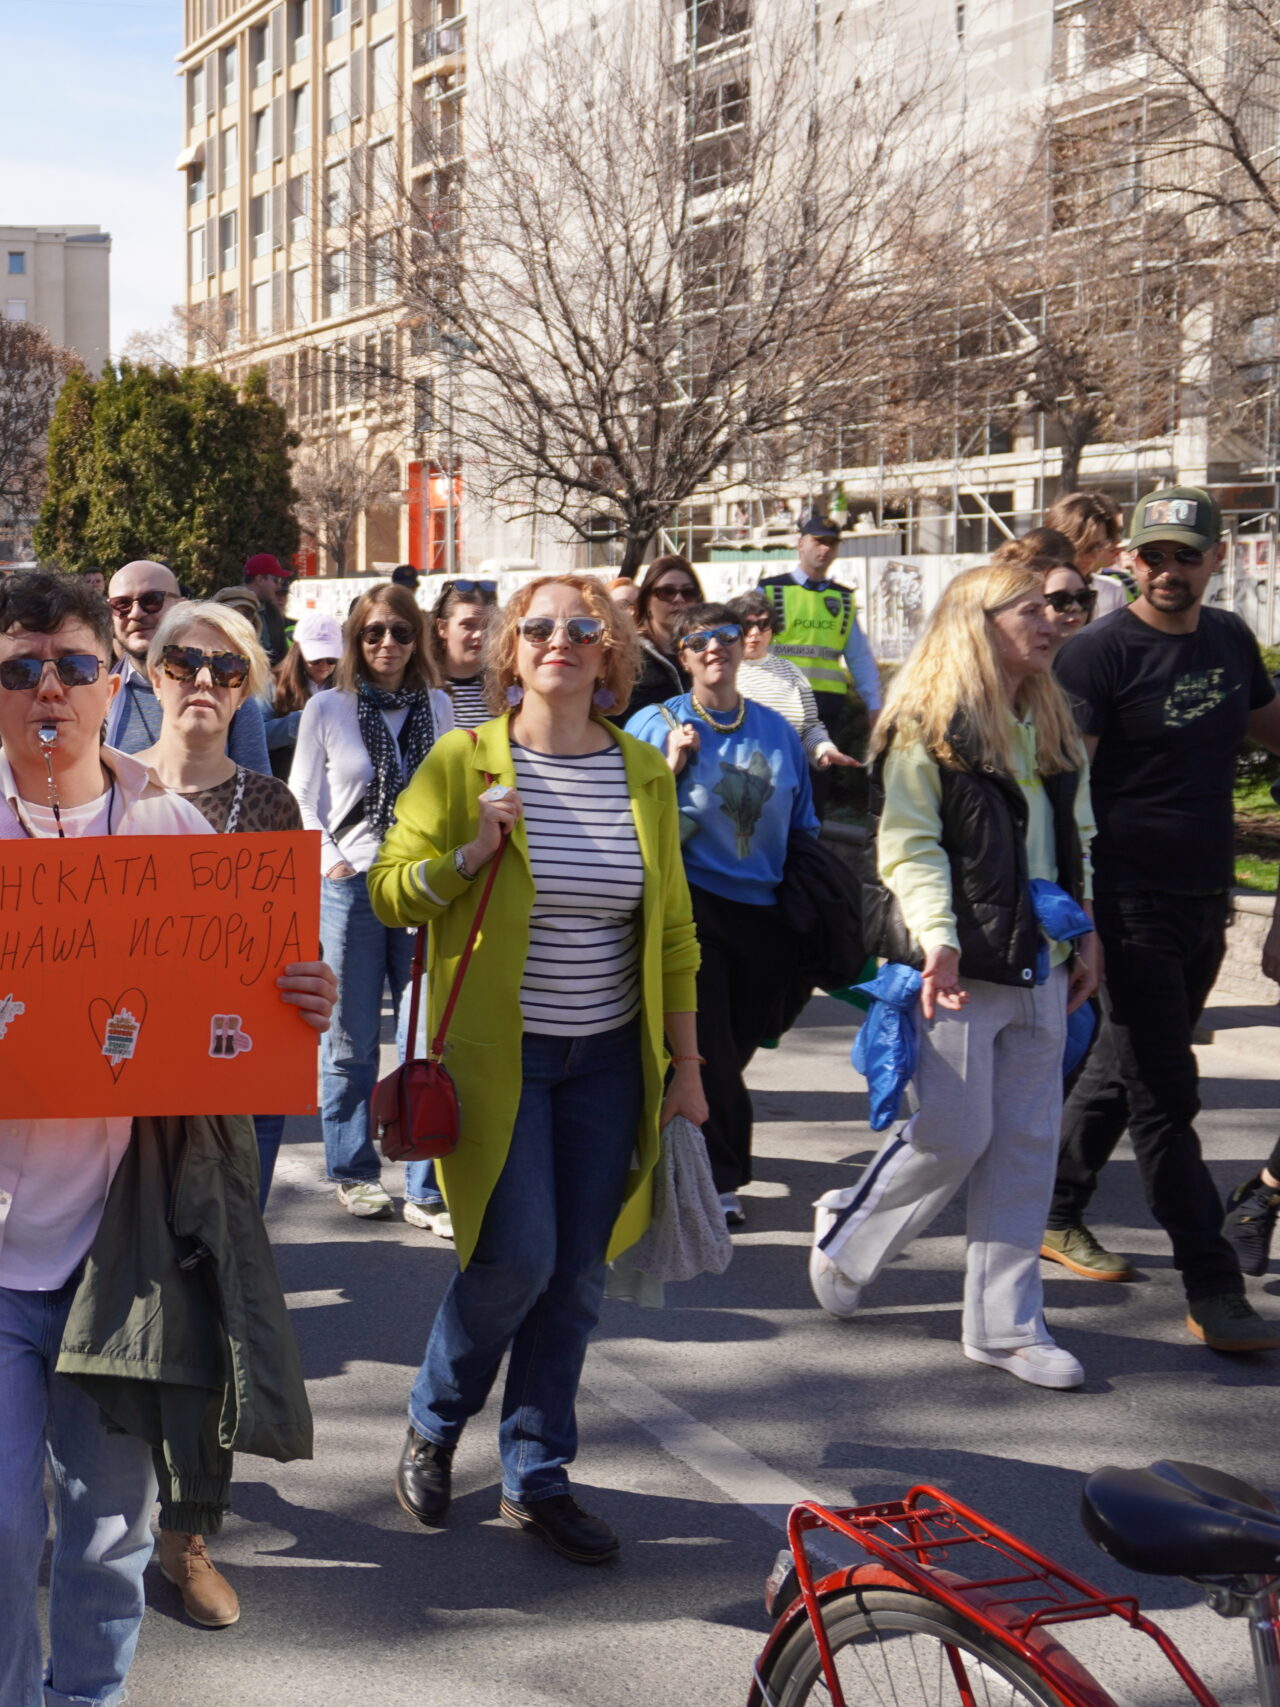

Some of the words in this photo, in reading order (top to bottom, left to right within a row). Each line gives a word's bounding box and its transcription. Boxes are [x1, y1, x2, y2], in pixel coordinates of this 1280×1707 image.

[794, 619, 836, 630] POLICE
[190, 847, 297, 899] БОРБА
[0, 918, 97, 971] НАША
